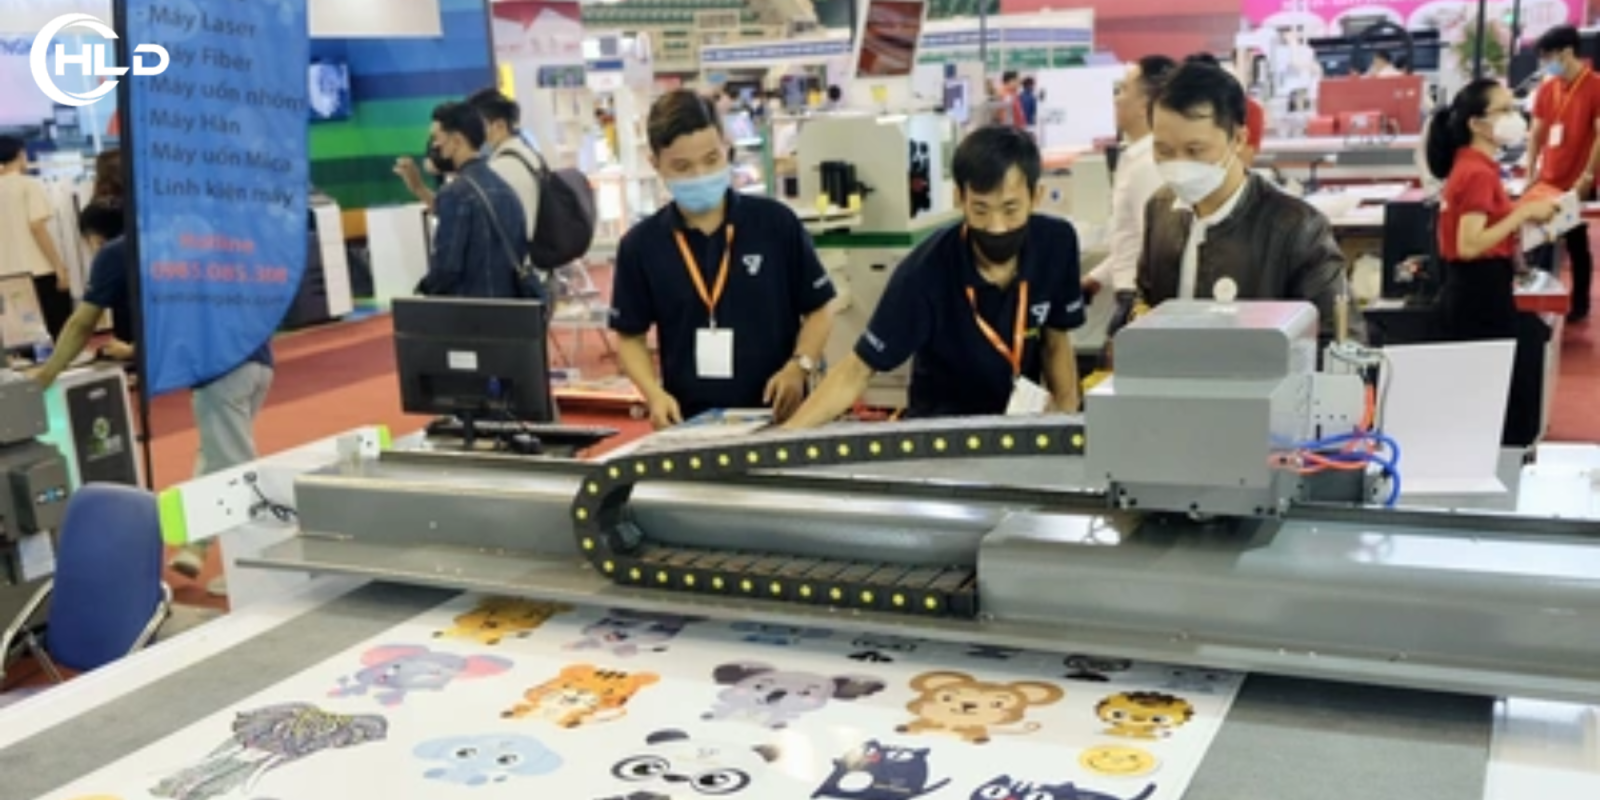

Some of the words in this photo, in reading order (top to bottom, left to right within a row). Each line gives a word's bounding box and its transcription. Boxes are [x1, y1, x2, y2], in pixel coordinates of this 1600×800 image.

[150, 5, 196, 31] Máy
[202, 12, 256, 38] Laser
[203, 46, 253, 72] Fiber
[150, 76, 195, 99] Máy
[150, 108, 195, 132] Máy
[152, 141, 197, 166] Máy
[153, 177, 200, 197] Linh
